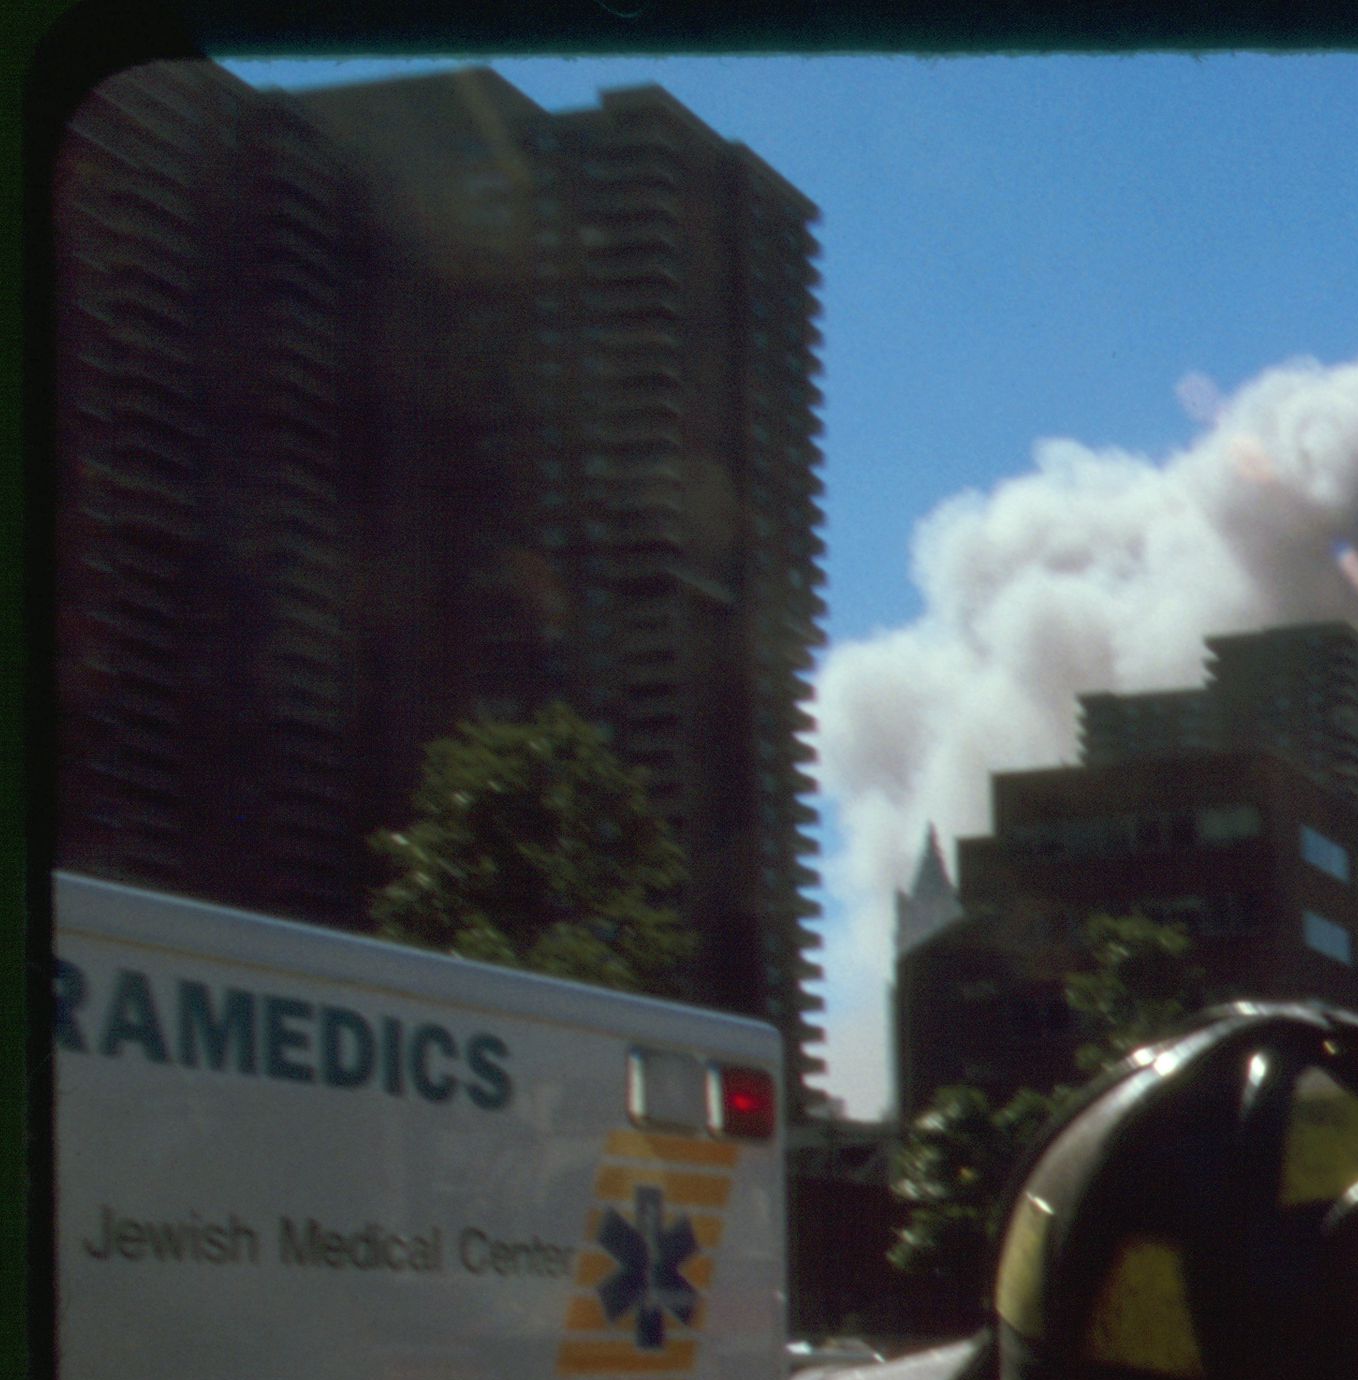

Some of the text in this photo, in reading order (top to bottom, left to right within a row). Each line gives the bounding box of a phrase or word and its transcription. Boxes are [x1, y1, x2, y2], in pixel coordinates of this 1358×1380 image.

[83, 1207, 578, 1281] Jewish Medical Center
